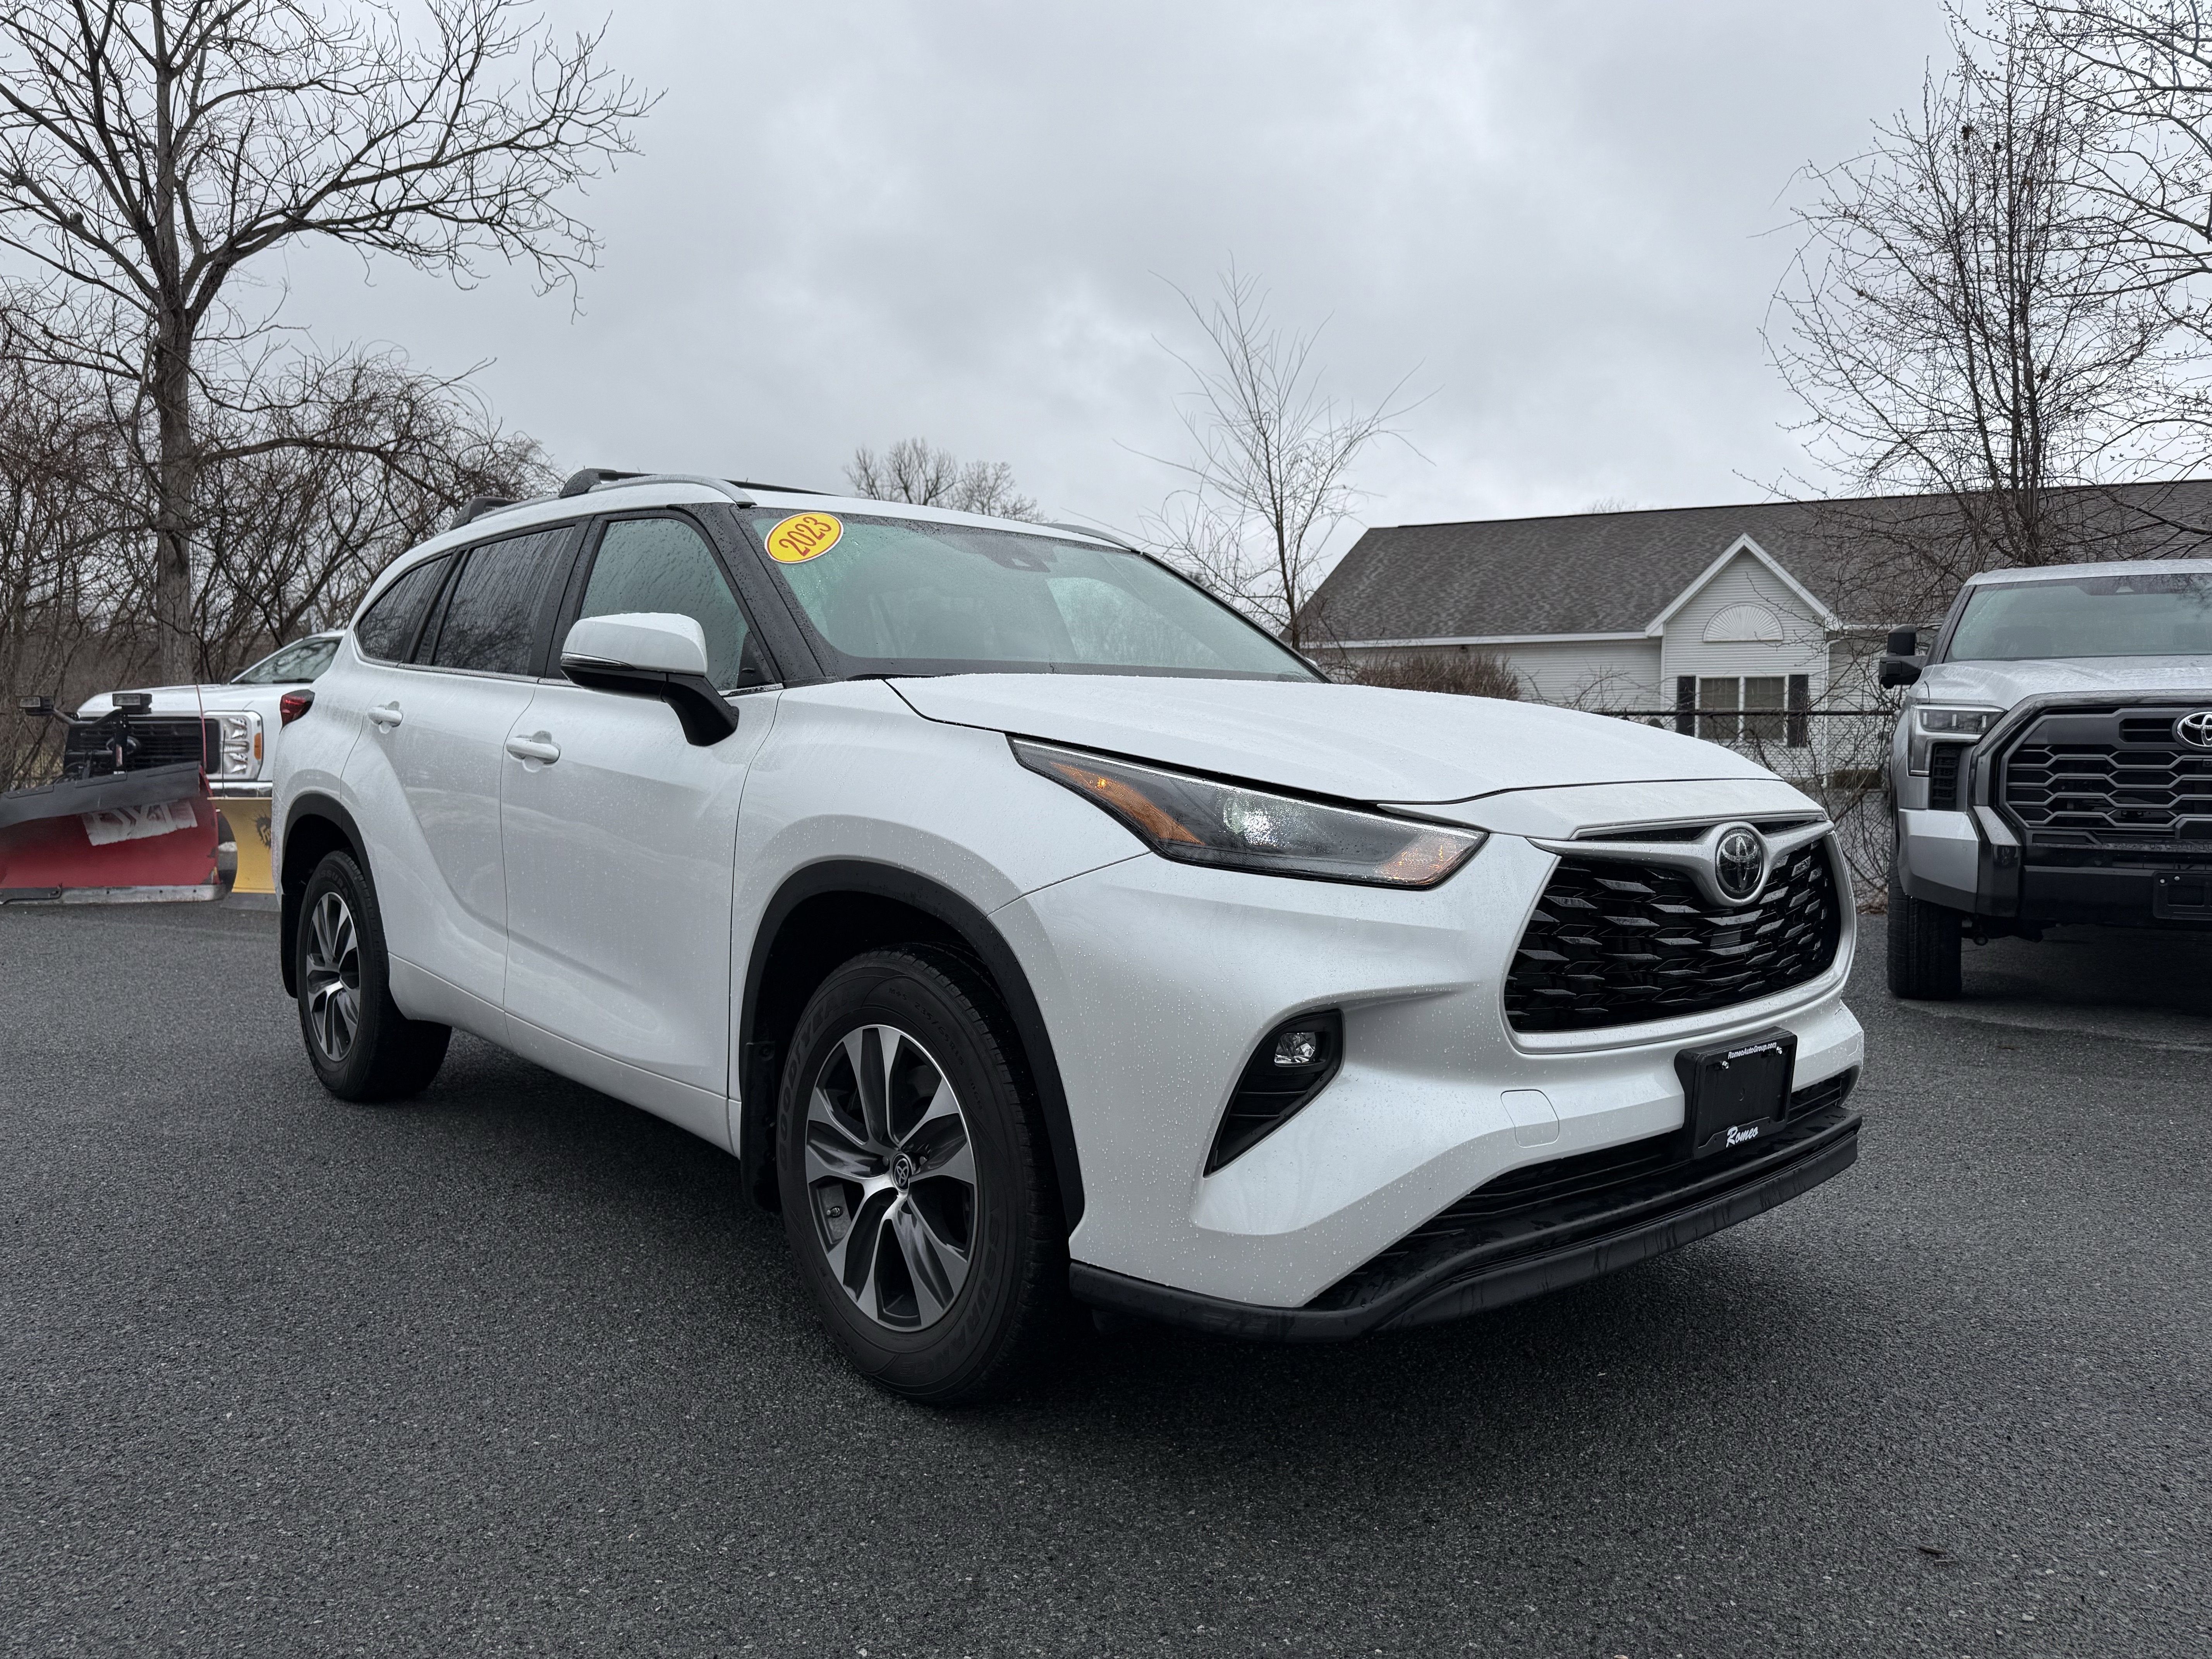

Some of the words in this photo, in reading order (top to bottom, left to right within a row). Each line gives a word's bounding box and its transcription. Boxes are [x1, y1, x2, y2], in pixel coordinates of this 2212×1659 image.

[779, 517, 831, 556] 2023
[914, 1002, 965, 1066] 235/65R18
[1728, 1042, 1777, 1060] RomeoAutoGroup.com
[1726, 1126, 1759, 1147] Romeo
